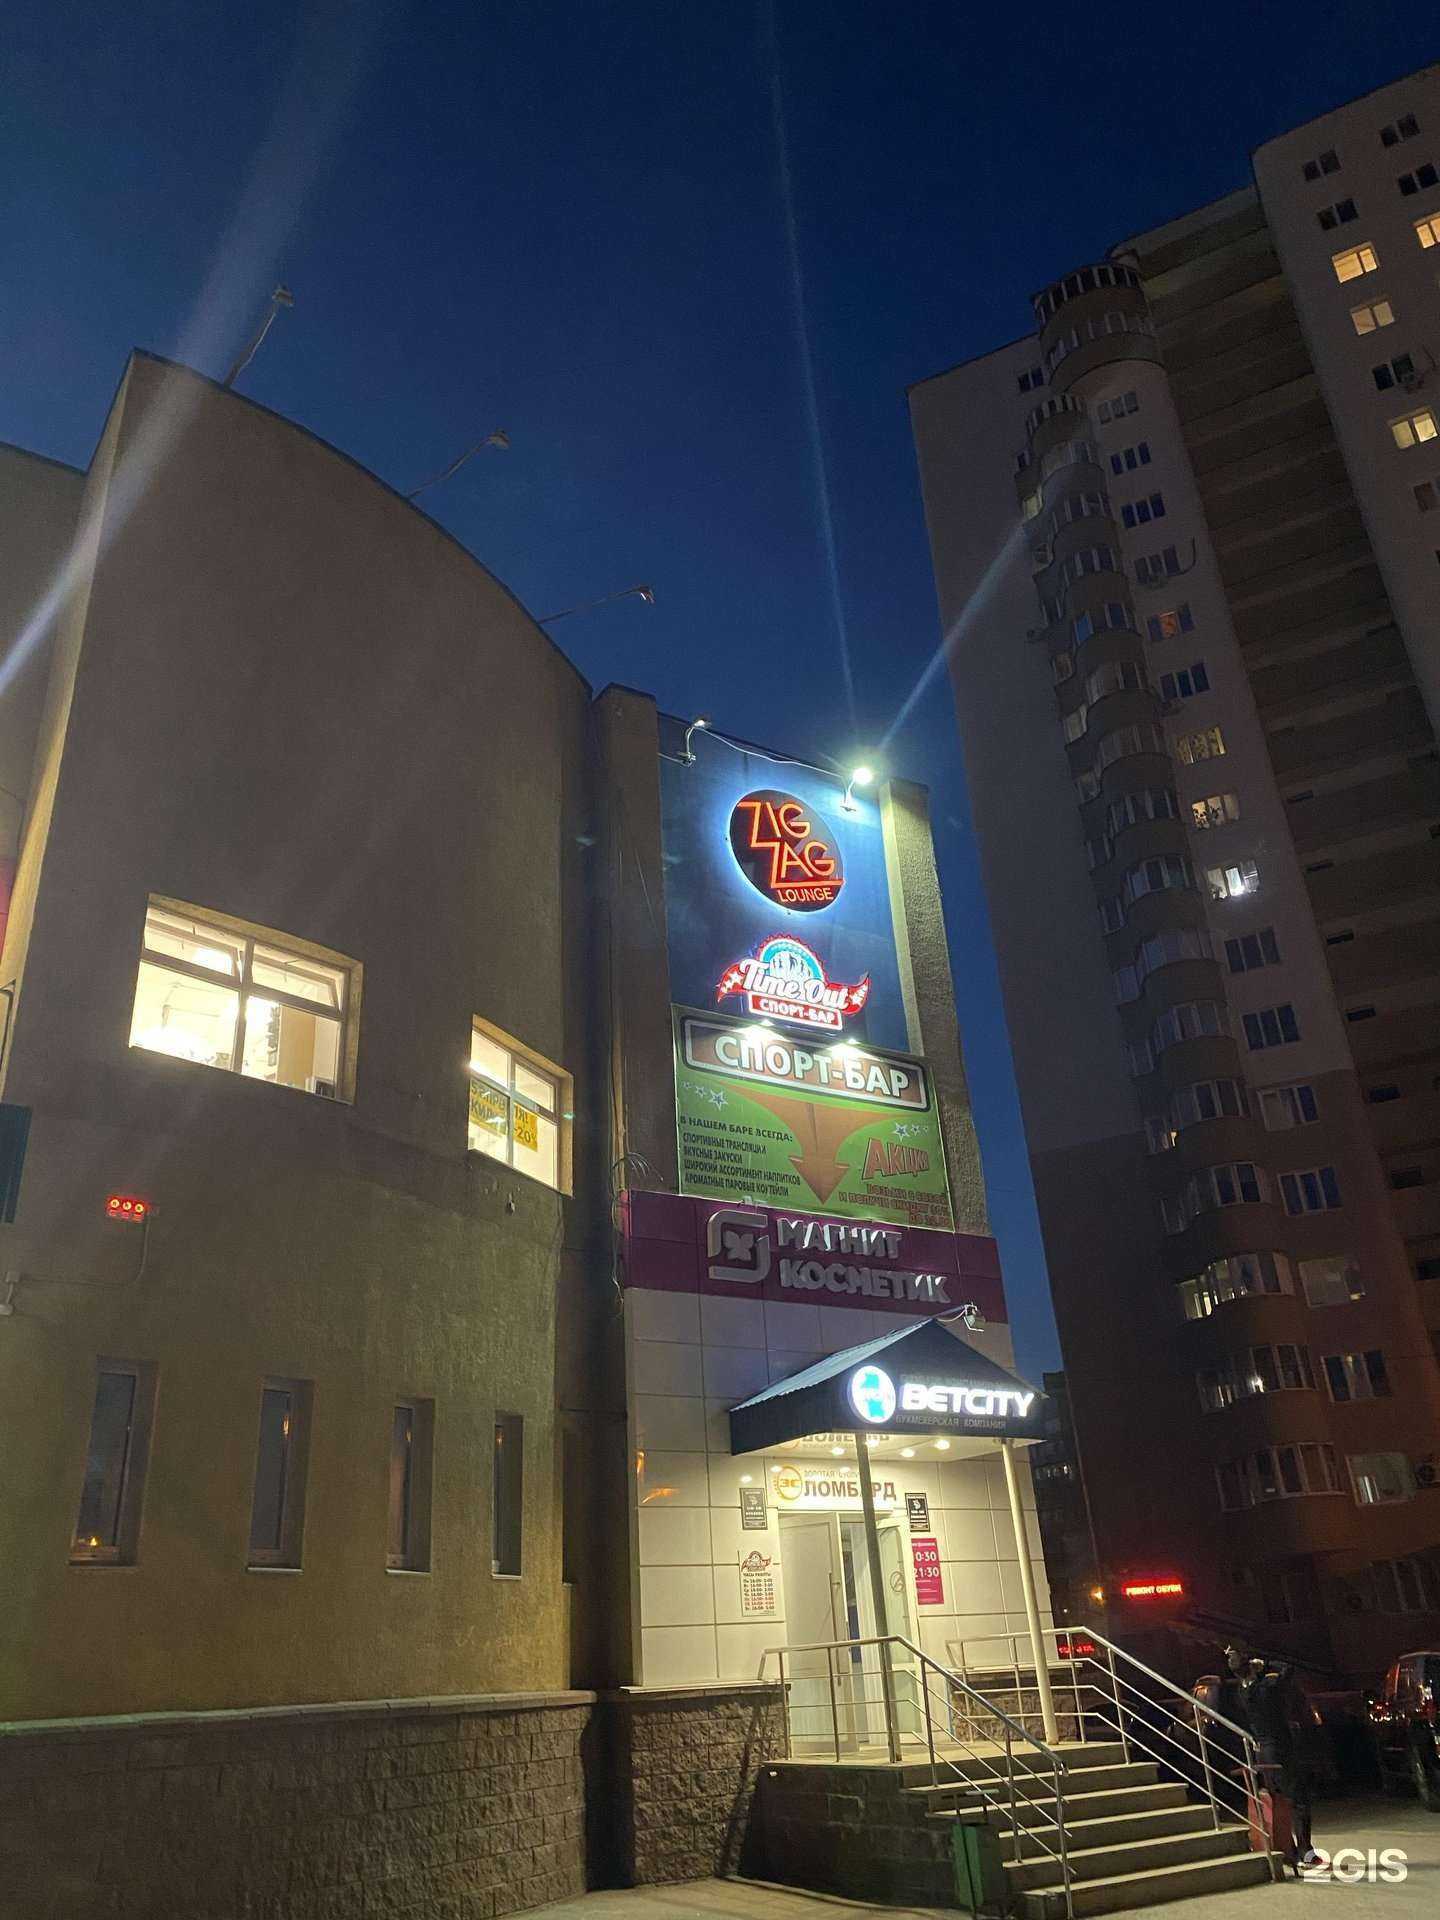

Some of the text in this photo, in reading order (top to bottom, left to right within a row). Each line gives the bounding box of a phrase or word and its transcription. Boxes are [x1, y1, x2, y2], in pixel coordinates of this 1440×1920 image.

[737, 802, 811, 848] ZIG
[771, 841, 845, 888] ZAG
[778, 887, 834, 902] LOUNGE
[739, 959, 851, 1009] Time Out
[760, 998, 836, 1025] СПОРТ-БАР
[714, 1034, 909, 1098] СПОРТ-БАР
[689, 1118, 727, 1132] НАШЕМ
[729, 1124, 753, 1136] БАРЕ
[776, 1217, 902, 1259] МАГНИТ
[779, 1258, 951, 1303] КОСМЕТИК
[902, 1382, 1035, 1417] BETCITY
[804, 1480, 896, 1500] ЛОМБРД
